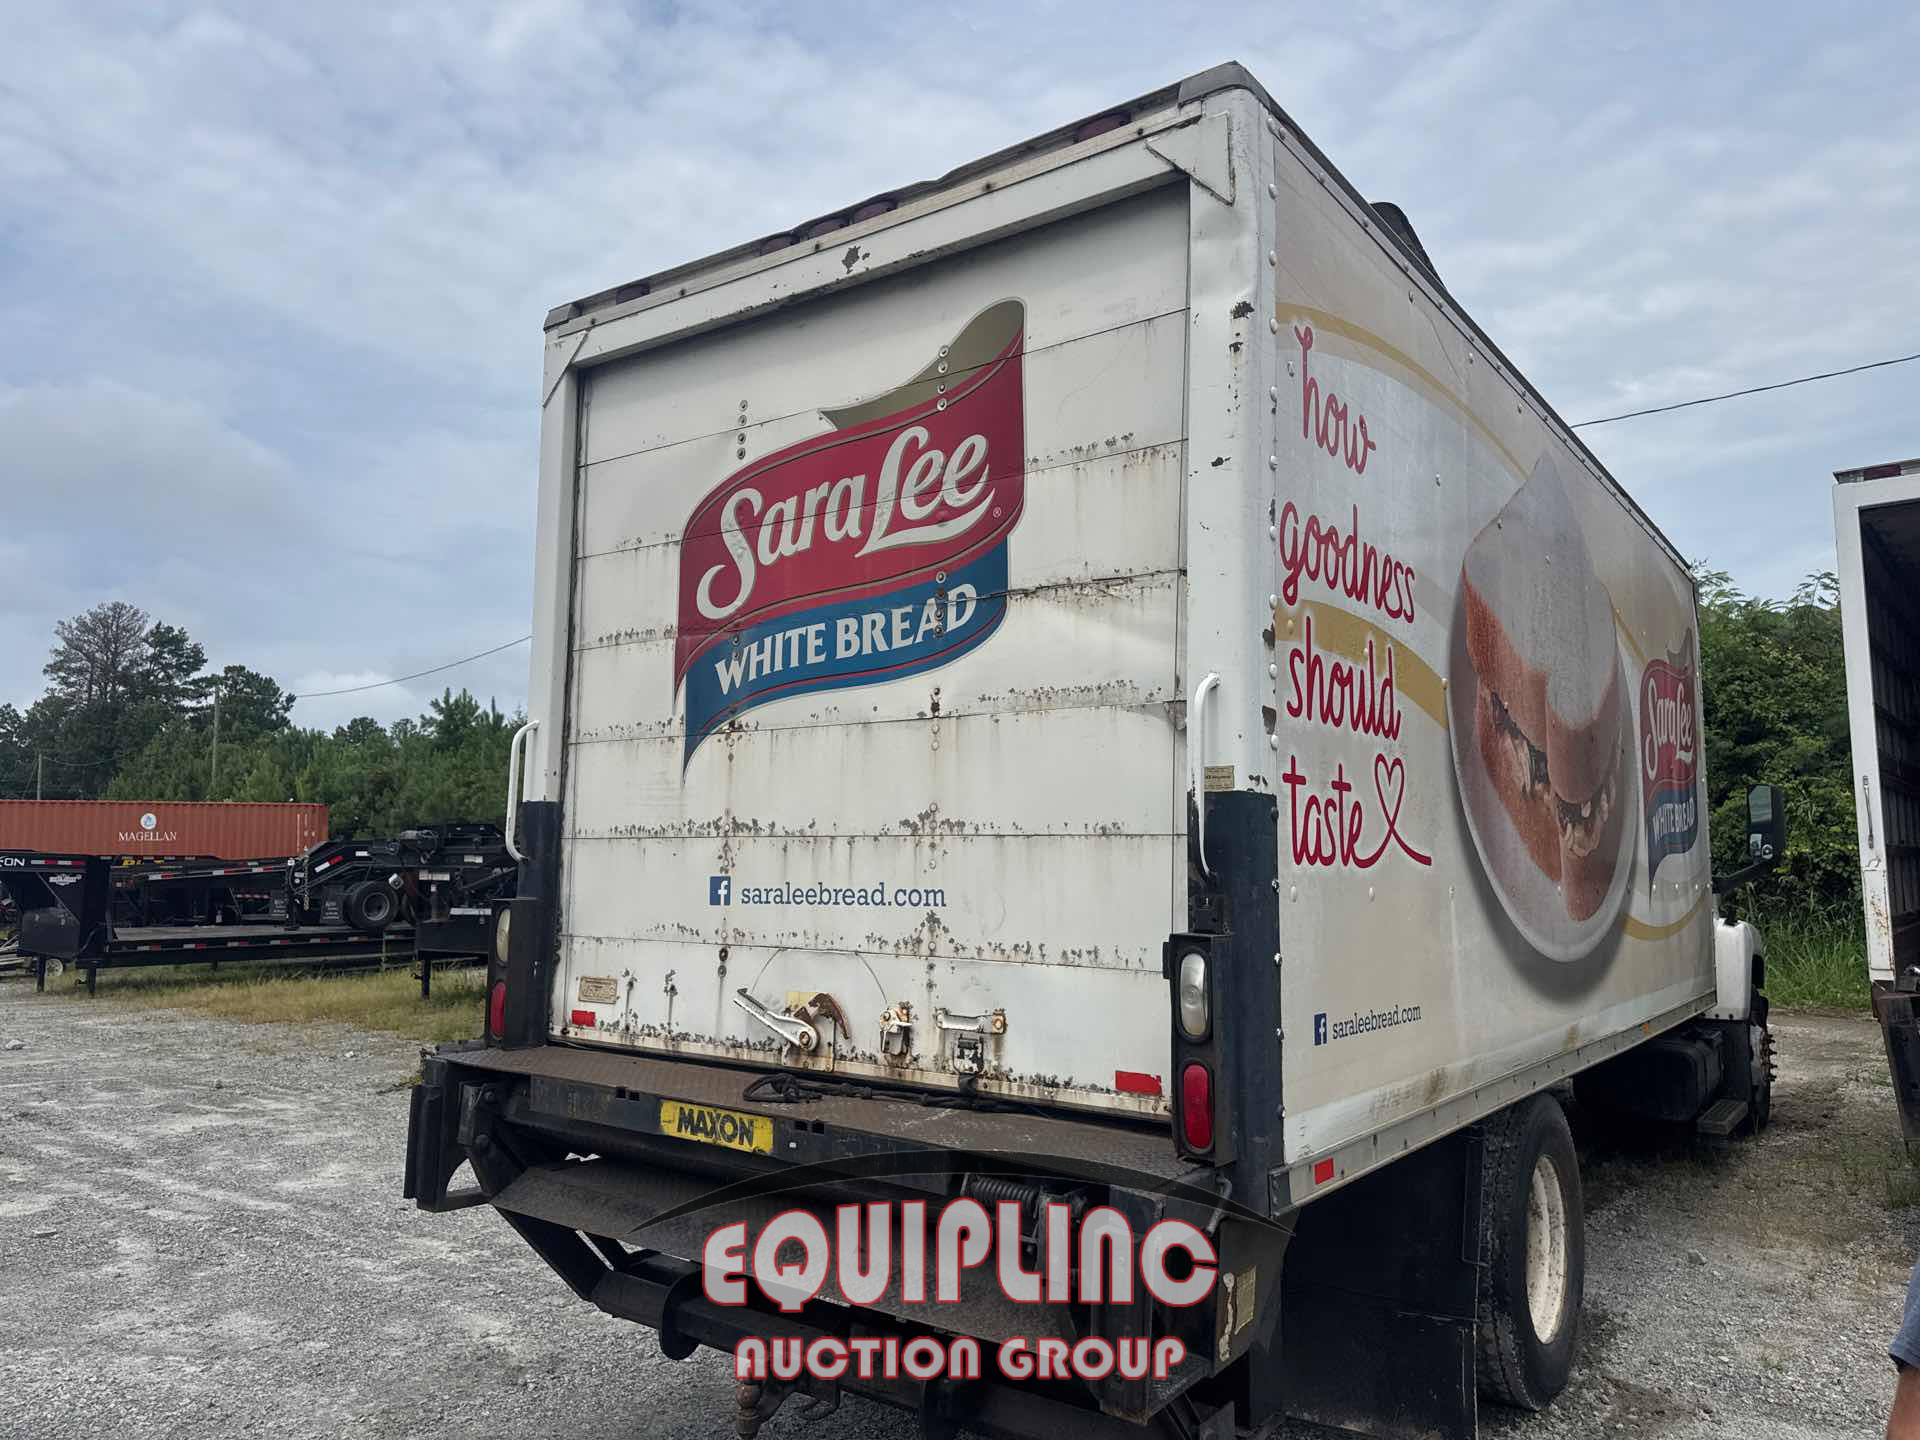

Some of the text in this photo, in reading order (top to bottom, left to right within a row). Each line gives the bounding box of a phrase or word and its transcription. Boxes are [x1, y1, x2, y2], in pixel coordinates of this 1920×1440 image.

[1294, 325, 1376, 474] how
[696, 425, 995, 619] Sara Lee
[1279, 501, 1415, 622] goodness
[714, 583, 977, 695] WHITE BREAD
[1286, 615, 1401, 740] should
[1645, 677, 1694, 781] Sara Lee
[0, 856, 25, 866] ON
[118, 831, 177, 841] MAGELLAN
[1282, 754, 1375, 868] taste
[1652, 798, 1695, 841] WHITE BREAD
[741, 881, 947, 907] saraleebread.com
[1332, 1004, 1421, 1039] saraleebread.com
[677, 1106, 754, 1147] MAXON
